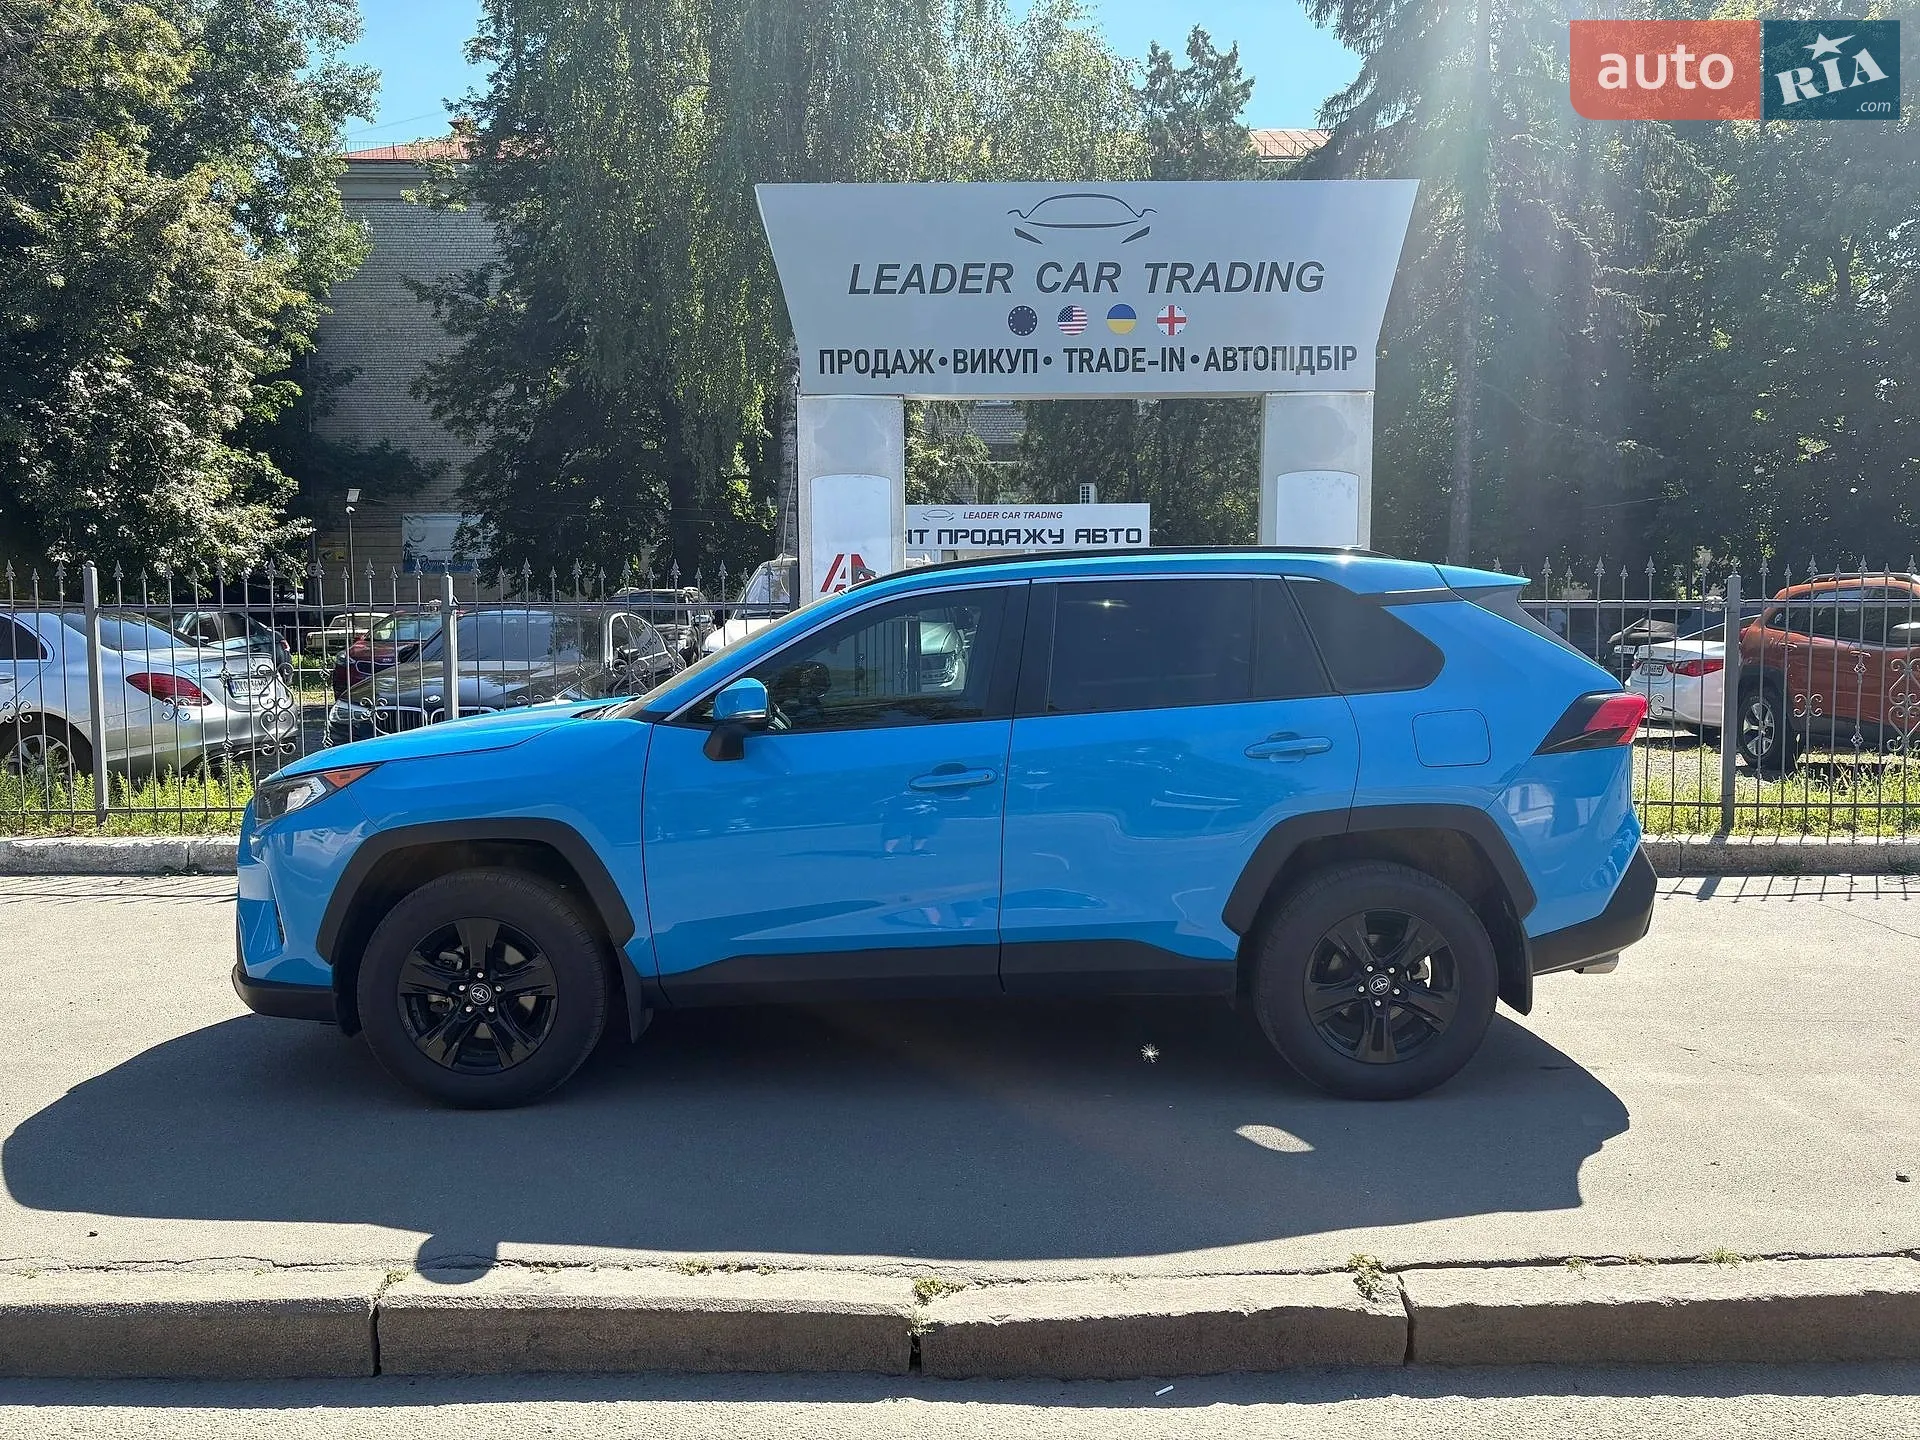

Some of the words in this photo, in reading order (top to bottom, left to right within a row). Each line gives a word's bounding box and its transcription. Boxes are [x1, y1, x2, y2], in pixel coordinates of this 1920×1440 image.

[848, 262, 1014, 295] LEADER
[1036, 261, 1122, 294] CAR
[1144, 261, 1325, 294] TRADING
[819, 348, 936, 379] ПРОДАЖ
[953, 347, 1038, 375] ВИКУП
[1063, 346, 1185, 374] TRADE-IN
[1203, 345, 1358, 377] АВТОПІДБІР
[963, 511, 1000, 520] LEADER
[1001, 511, 1021, 520] CAR
[1023, 511, 1063, 520] TRADING
[905, 528, 930, 545] ІТ
[937, 528, 1065, 546] ПРОДАЖУ
[1075, 527, 1142, 544] АВТО
